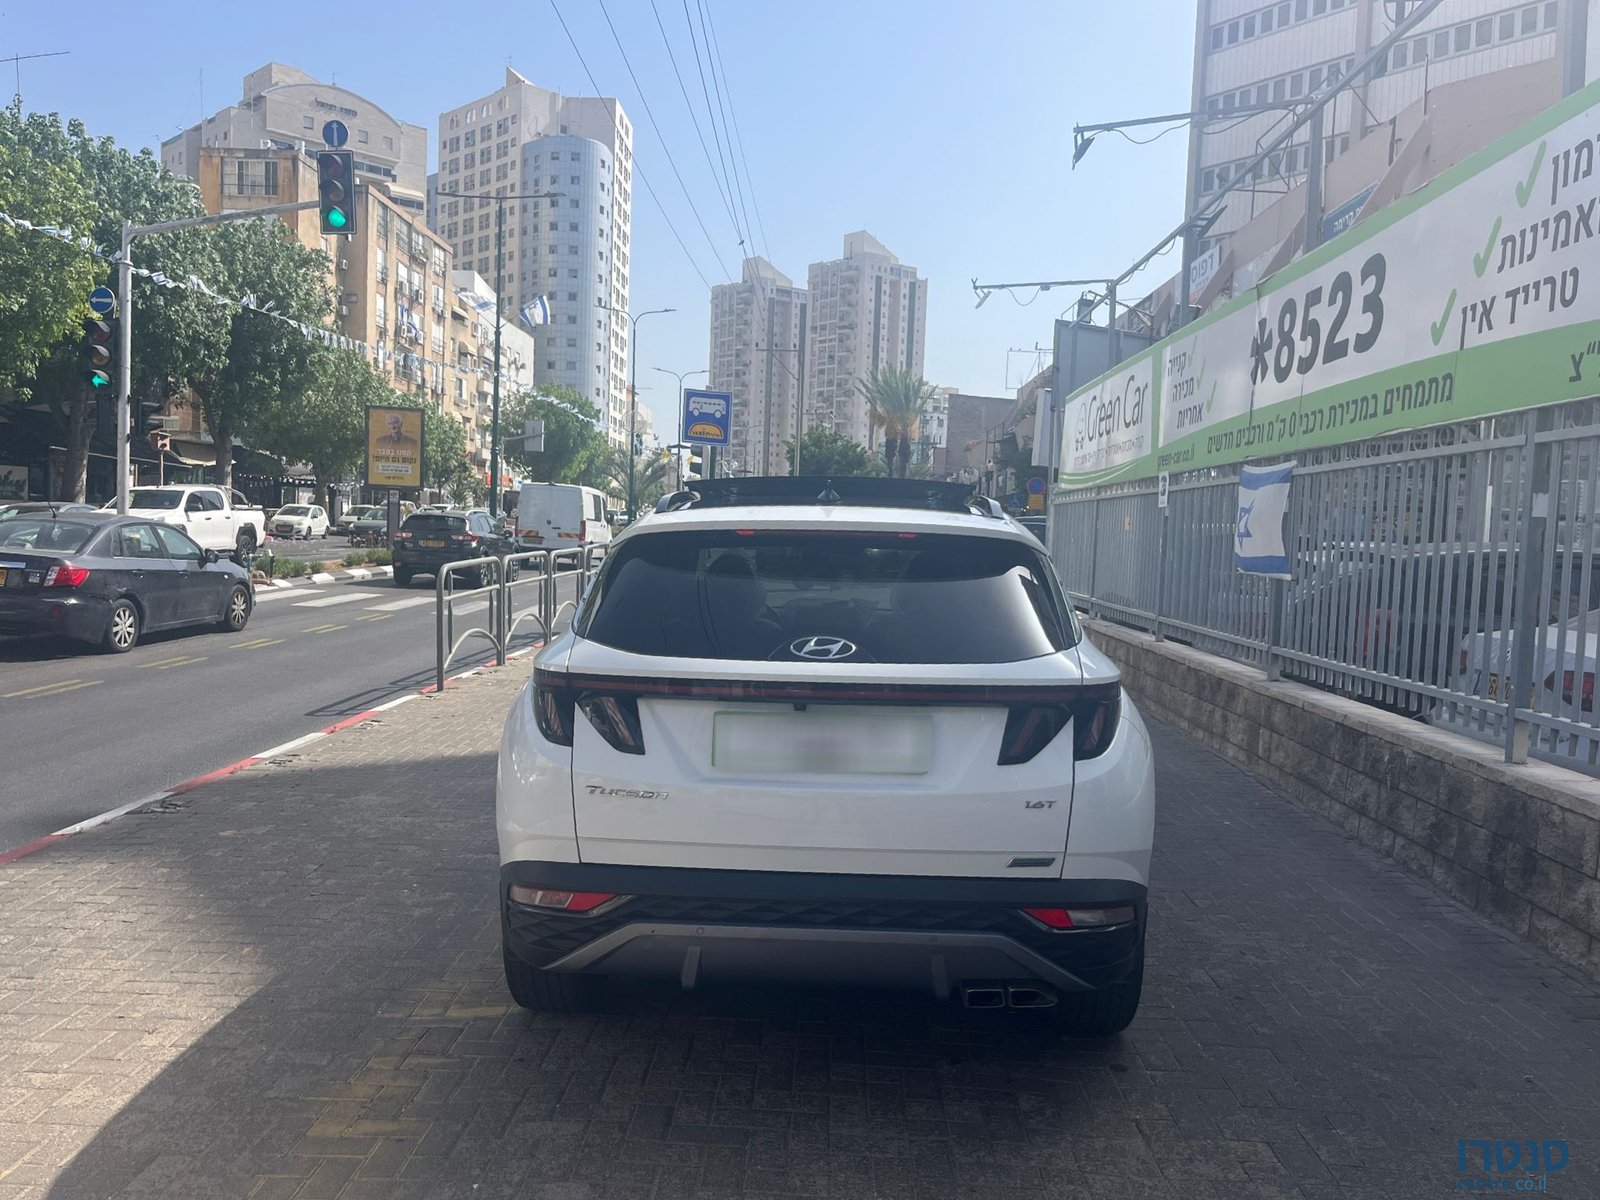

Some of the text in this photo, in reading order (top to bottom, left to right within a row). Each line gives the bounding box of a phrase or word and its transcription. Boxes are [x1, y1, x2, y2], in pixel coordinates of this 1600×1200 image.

[1551, 133, 1600, 206] מון
[1497, 197, 1600, 274] אמינות
[1191, 253, 1214, 283] דפוס
[1460, 266, 1579, 350] טרייד אין
[1167, 352, 1187, 378] קנייה
[1172, 377, 1195, 403] מכירה
[1383, 372, 1454, 416] מתמחים
[1088, 374, 1148, 442] Green Car
[1177, 402, 1204, 430] אחריות
[1300, 408, 1324, 435] רכבי
[1327, 393, 1378, 430] במכירת
[1207, 431, 1234, 454] חדשים
[1235, 423, 1264, 449] ורכבים
